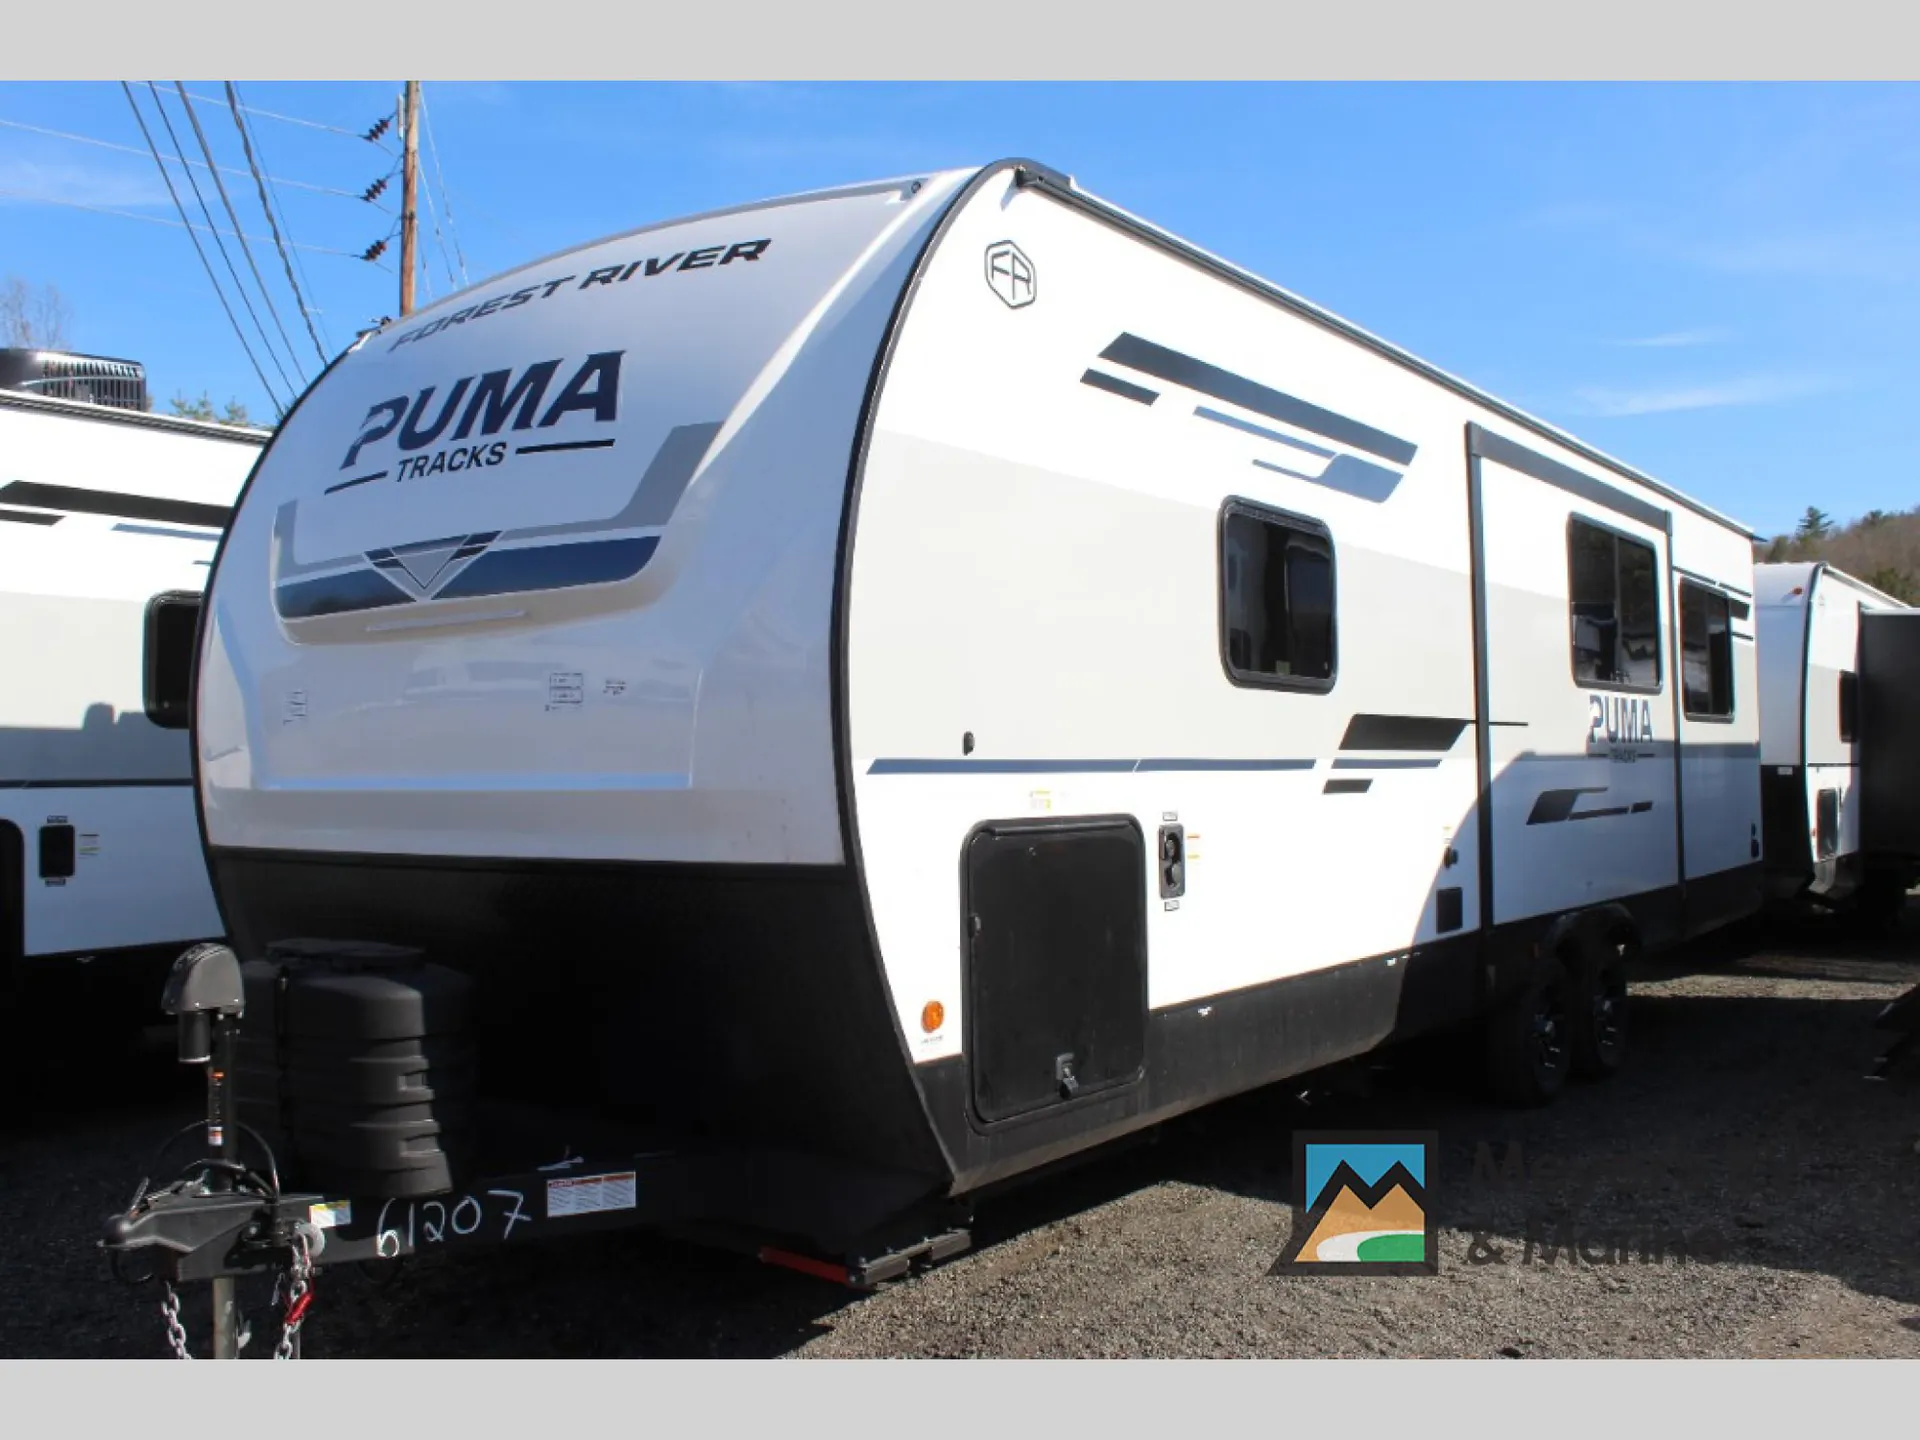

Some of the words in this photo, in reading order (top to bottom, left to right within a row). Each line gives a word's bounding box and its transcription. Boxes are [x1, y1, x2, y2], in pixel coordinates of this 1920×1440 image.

[388, 274, 577, 353] FOREST
[577, 238, 772, 290] RIVER
[339, 350, 627, 471] PUMA
[396, 442, 507, 482] TRACKS
[1588, 694, 1653, 743] PUMA
[376, 1189, 532, 1258] 61207
